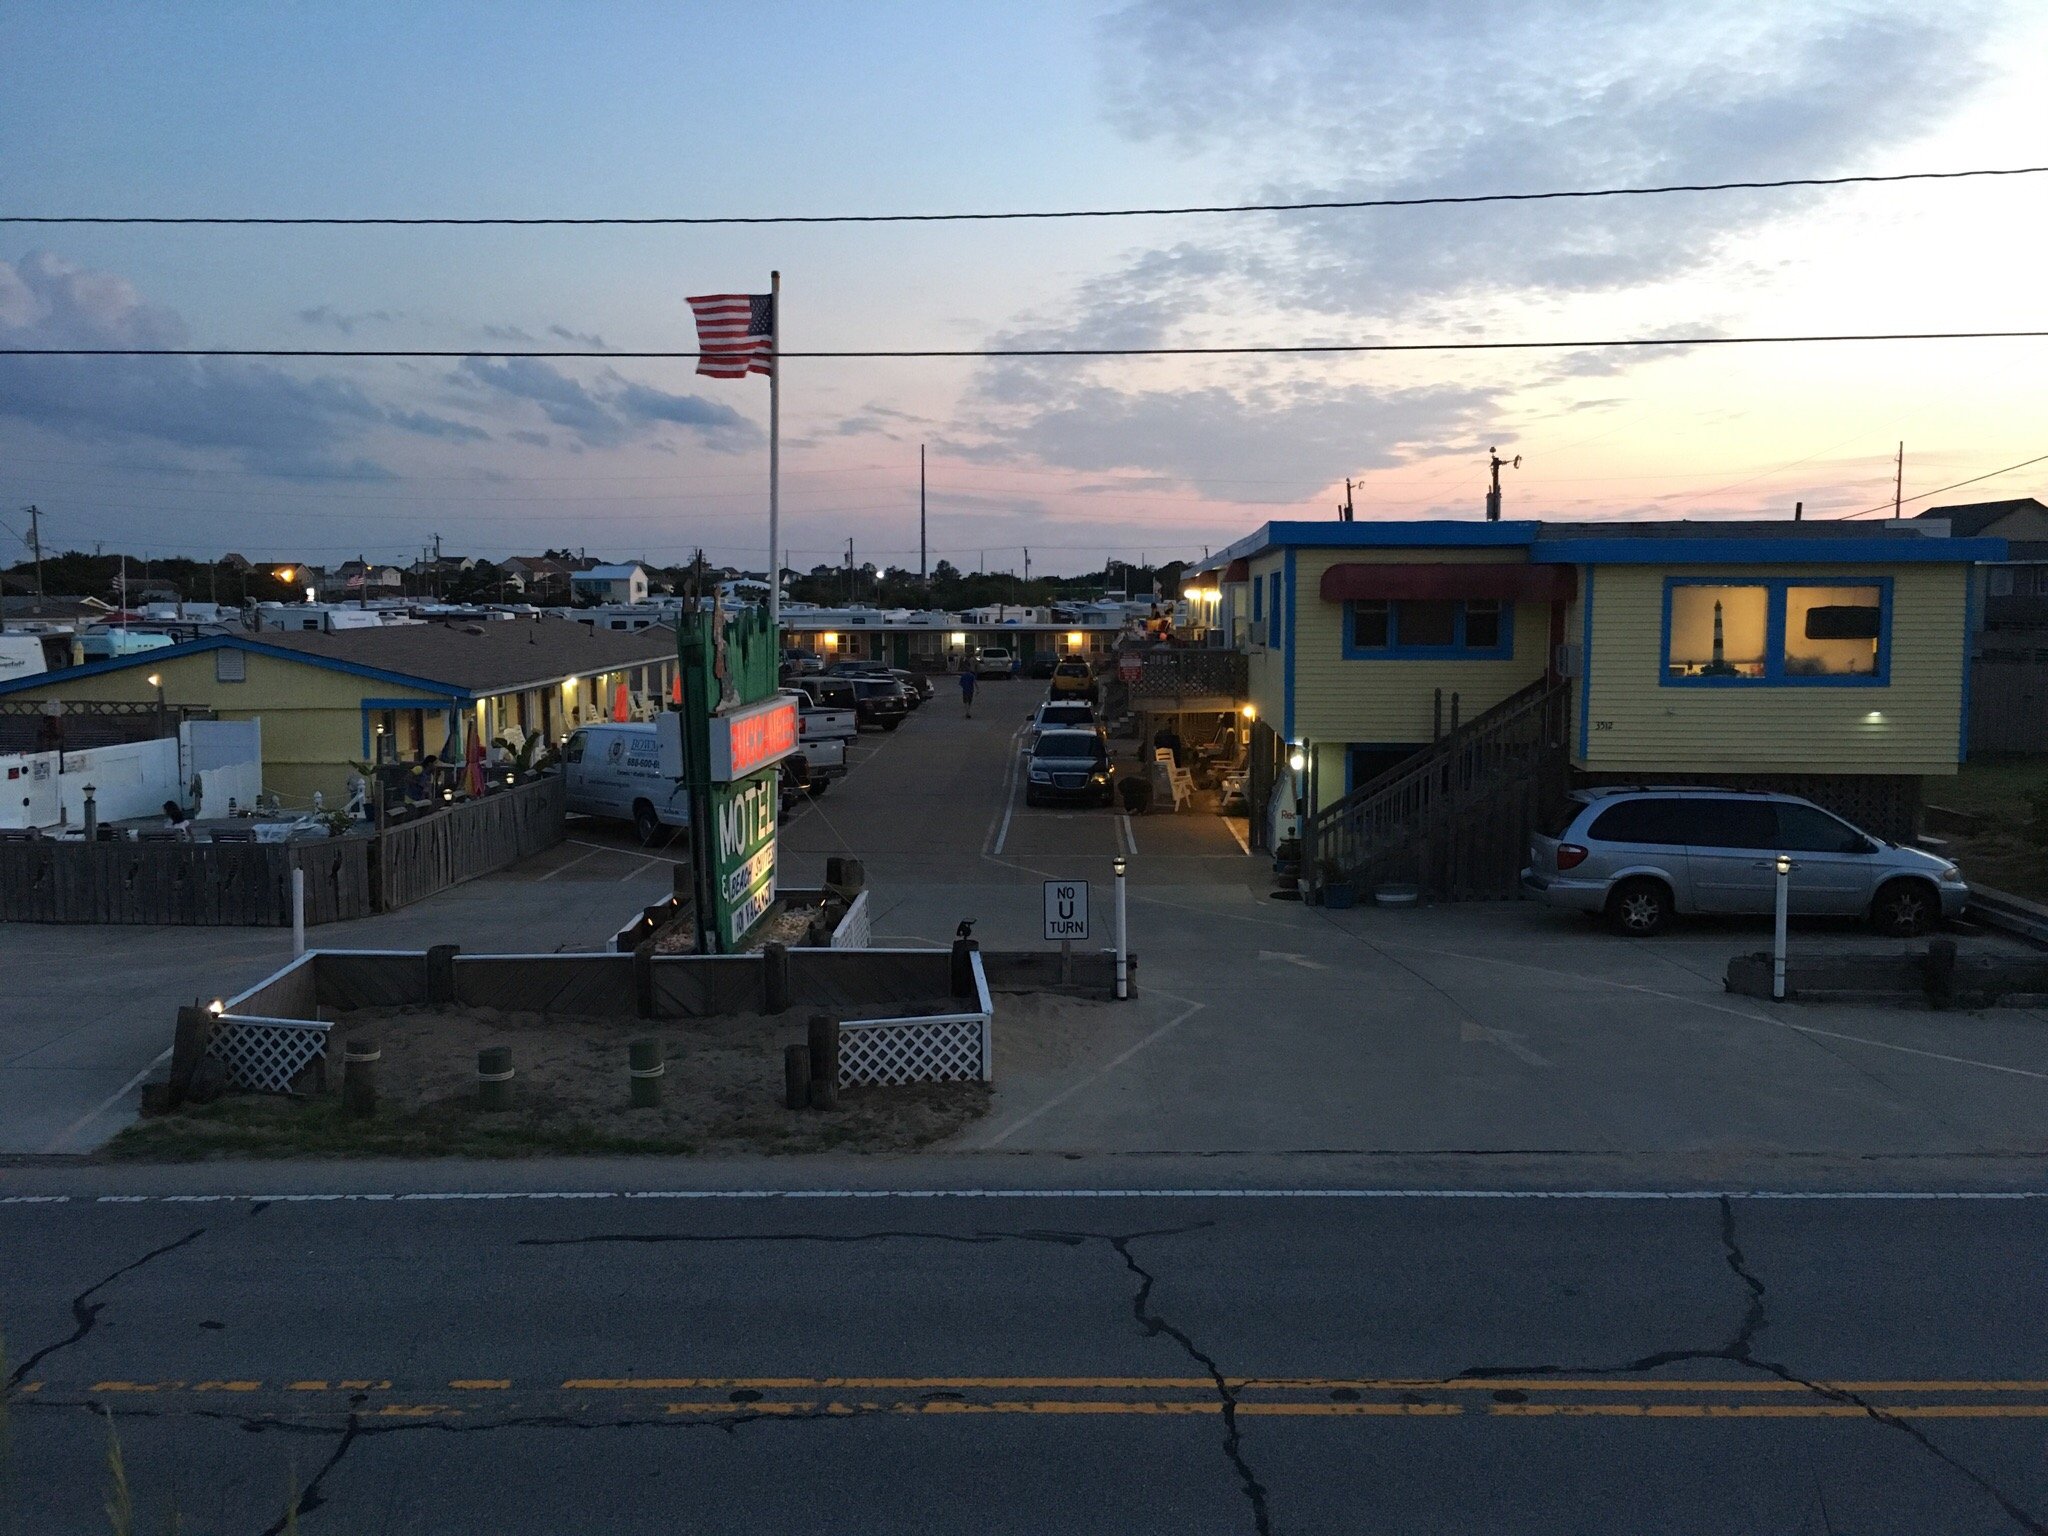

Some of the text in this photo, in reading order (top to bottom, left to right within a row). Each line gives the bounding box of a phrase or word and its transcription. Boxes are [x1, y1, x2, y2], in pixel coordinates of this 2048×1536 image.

[1595, 721, 1613, 731] 3512
[719, 780, 775, 864] MOTEL
[731, 861, 754, 899] BEACH
[1057, 886, 1075, 899] NO
[746, 881, 772, 926] VACANCY
[1059, 901, 1073, 919] U
[1050, 921, 1084, 934] TURN
